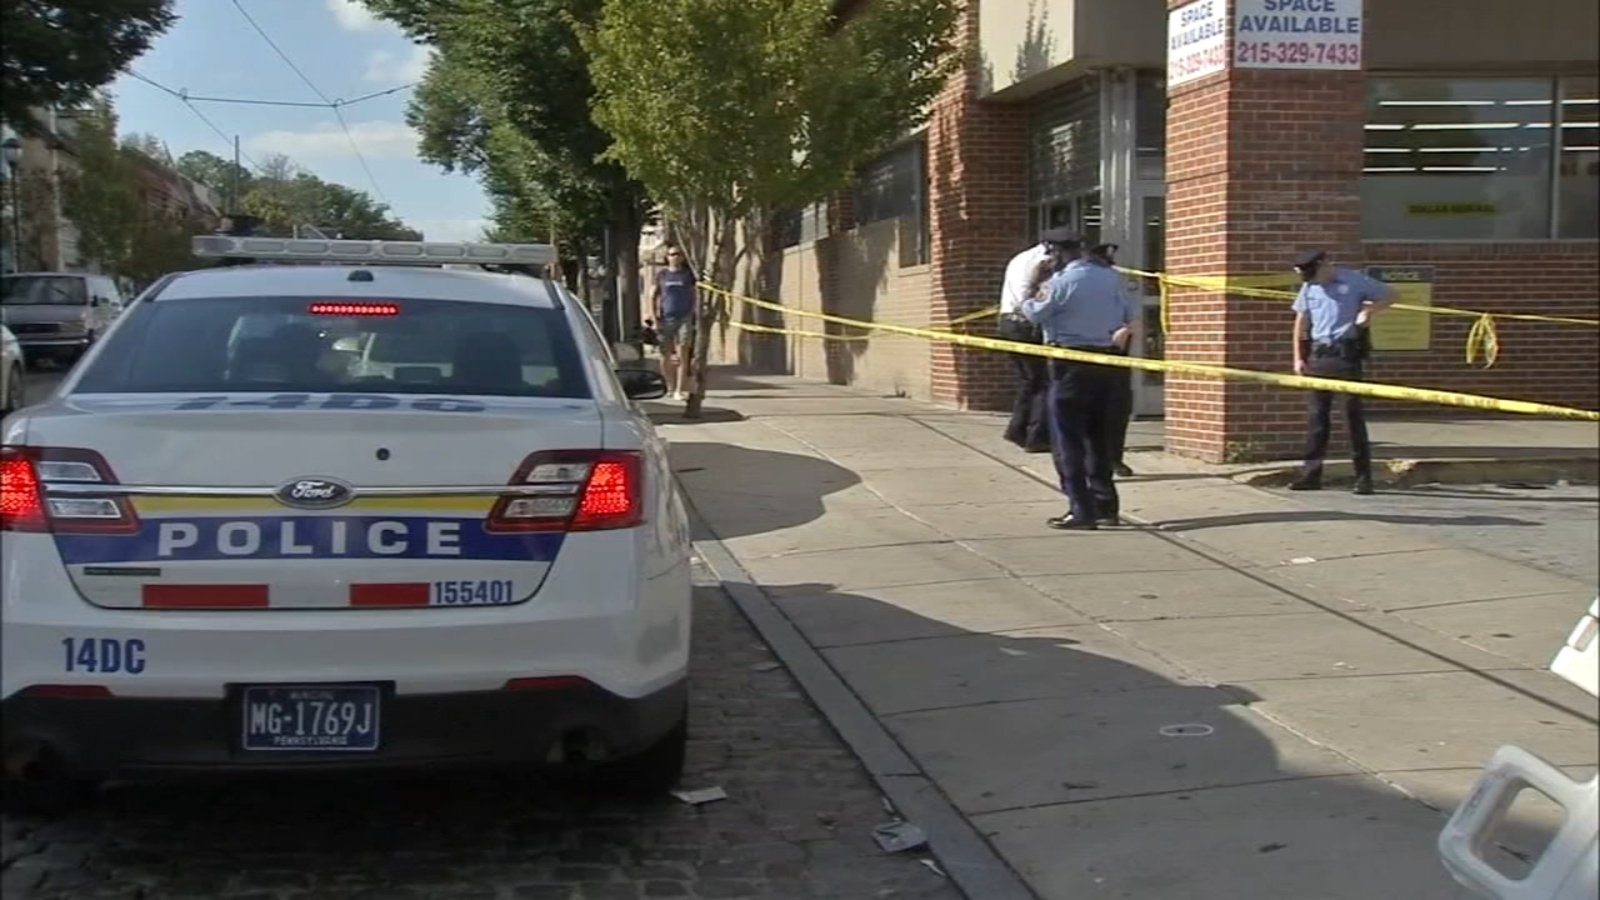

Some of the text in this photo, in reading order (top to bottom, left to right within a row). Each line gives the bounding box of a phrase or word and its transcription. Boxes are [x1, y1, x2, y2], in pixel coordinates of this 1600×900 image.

[1181, 1, 1214, 28] SPACE
[1264, 0, 1336, 12] SPACE
[1170, 17, 1225, 51] AVAILABLE
[1238, 15, 1360, 34] AVAILABLE
[1237, 42, 1360, 64] 215-329-7433
[173, 394, 486, 413] 14DC
[291, 480, 336, 498] Ford
[157, 521, 463, 557] POLICE
[434, 580, 513, 606] 155401
[62, 638, 146, 675] 14DC
[250, 701, 373, 736] MG-1769J
